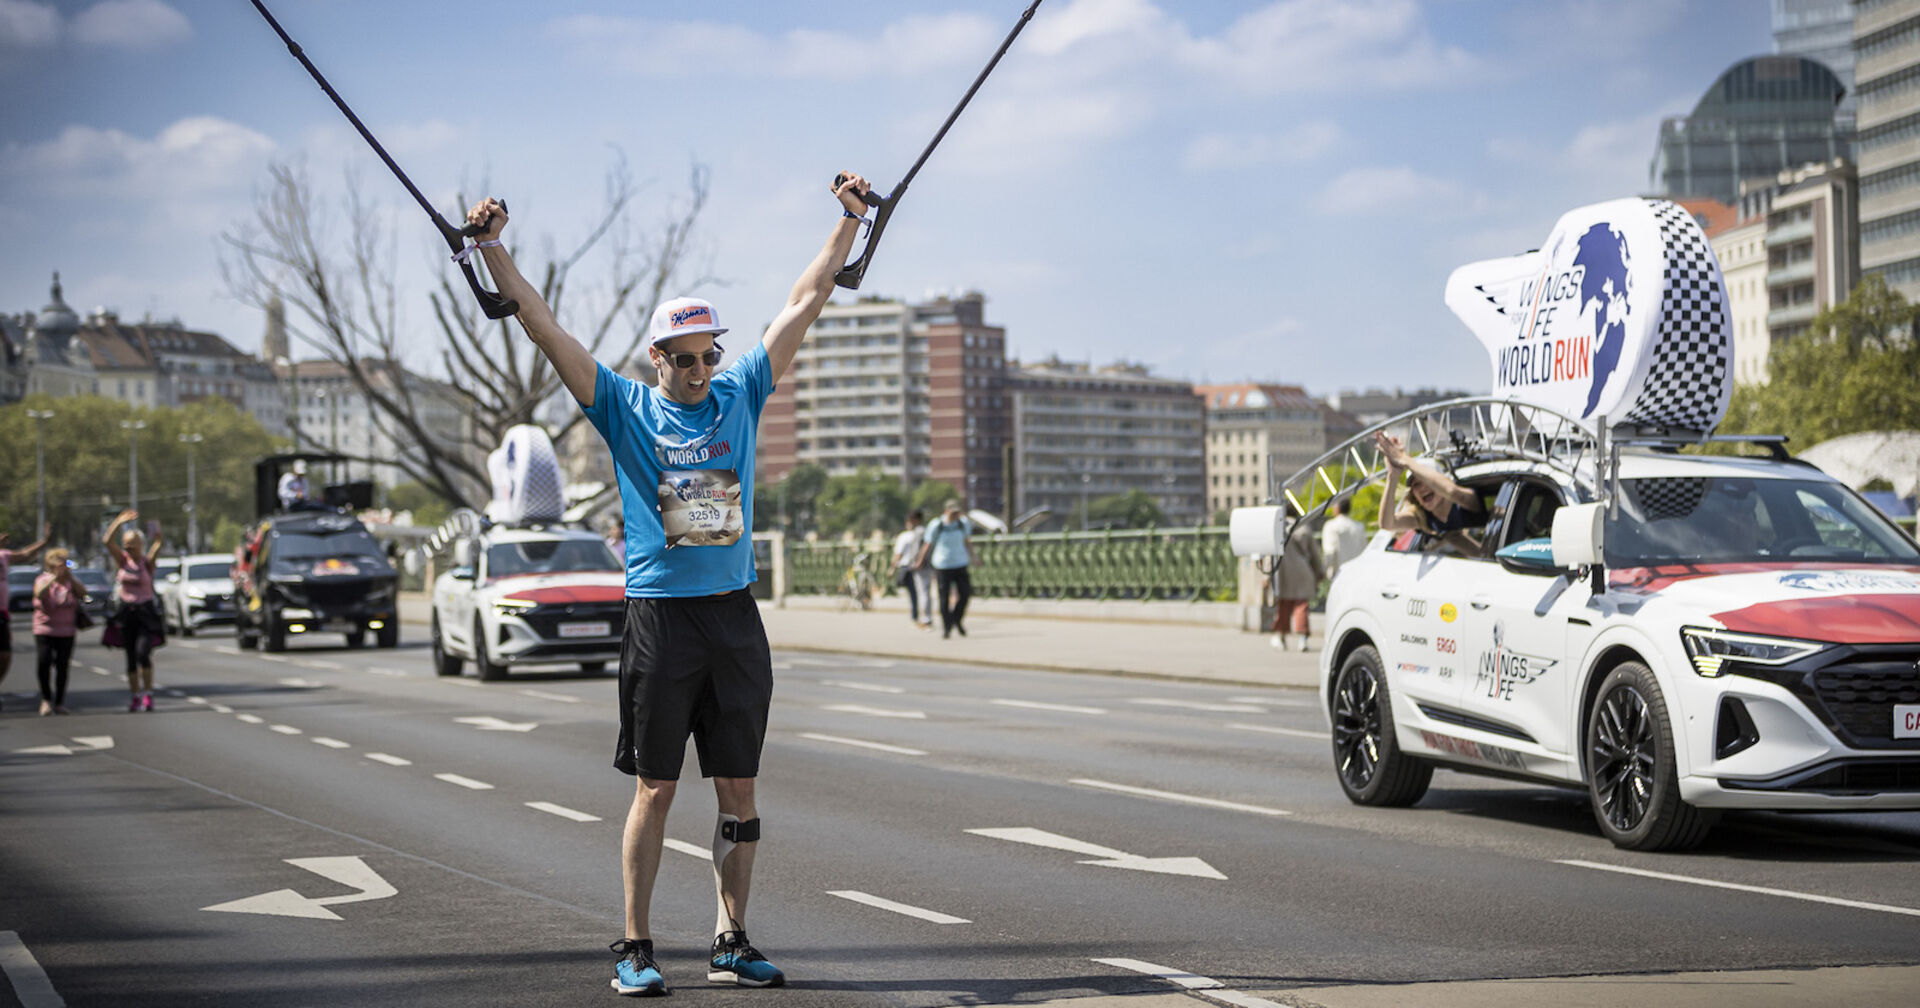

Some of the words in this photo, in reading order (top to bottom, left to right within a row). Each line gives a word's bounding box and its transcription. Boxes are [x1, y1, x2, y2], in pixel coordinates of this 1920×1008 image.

[1519, 268, 1582, 307] WINGS
[1518, 307, 1557, 340] LIFE
[1498, 342, 1551, 388] WORLD
[1554, 336, 1590, 382] RUN
[667, 447, 709, 465] WORLD
[708, 440, 731, 459] RUN
[712, 489, 727, 498] RUN
[688, 509, 720, 521] 32519
[1437, 637, 1456, 654] ERGO
[1482, 651, 1528, 679] WINGS
[1487, 677, 1515, 701] LIFE
